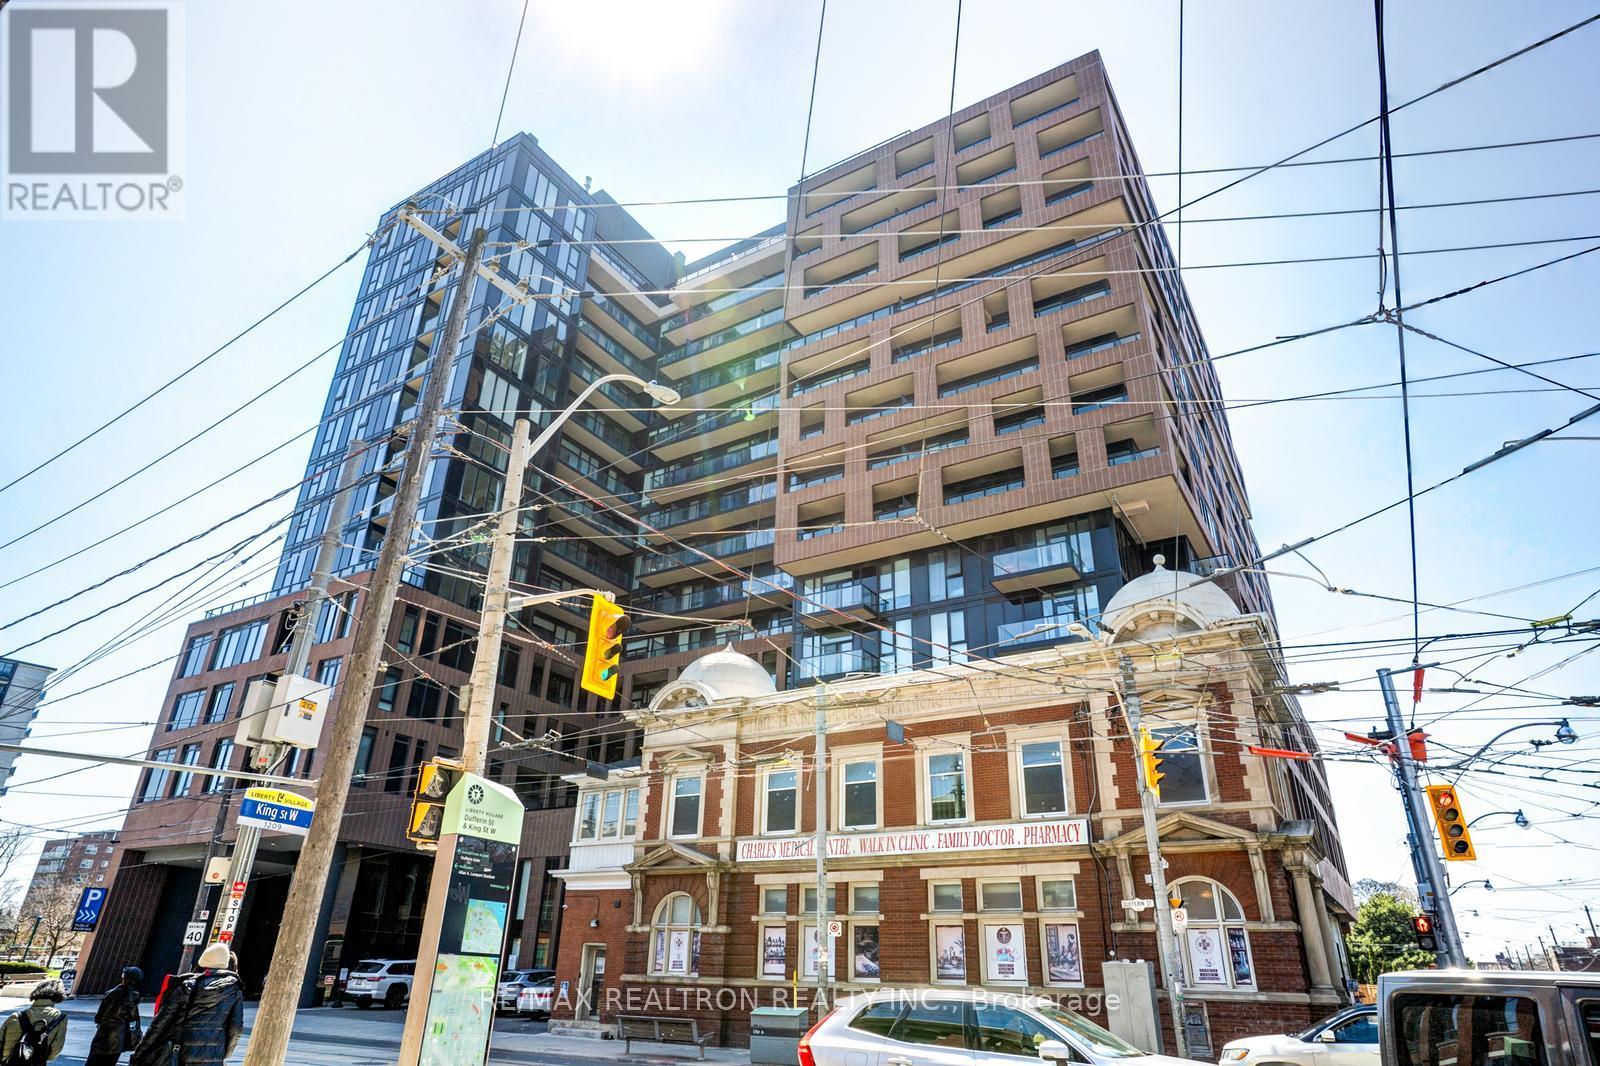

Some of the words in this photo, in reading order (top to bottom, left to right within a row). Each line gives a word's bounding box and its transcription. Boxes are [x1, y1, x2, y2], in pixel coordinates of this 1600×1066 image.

[302, 701, 314, 710] 212
[251, 791, 275, 801] LIBERTY
[285, 799, 308, 808] VILLAGE
[256, 803, 278, 820] King
[279, 809, 288, 820] St
[289, 809, 298, 821] W
[464, 814, 487, 824] Dufferin
[263, 821, 282, 830] 1209
[468, 823, 481, 833] King
[741, 840, 778, 859] CHARLES
[779, 839, 814, 859] MEDICAL
[827, 836, 850, 855] NTRE
[859, 835, 884, 854] WALK
[885, 835, 898, 852] IN
[899, 833, 930, 851] CLINIC
[938, 831, 971, 849] FAMILY
[973, 828, 1014, 847] DOCTOR
[1024, 823, 1080, 845] PHARMACY
[84, 889, 102, 908] P
[226, 899, 239, 930] STOP
[186, 931, 202, 942] 40
